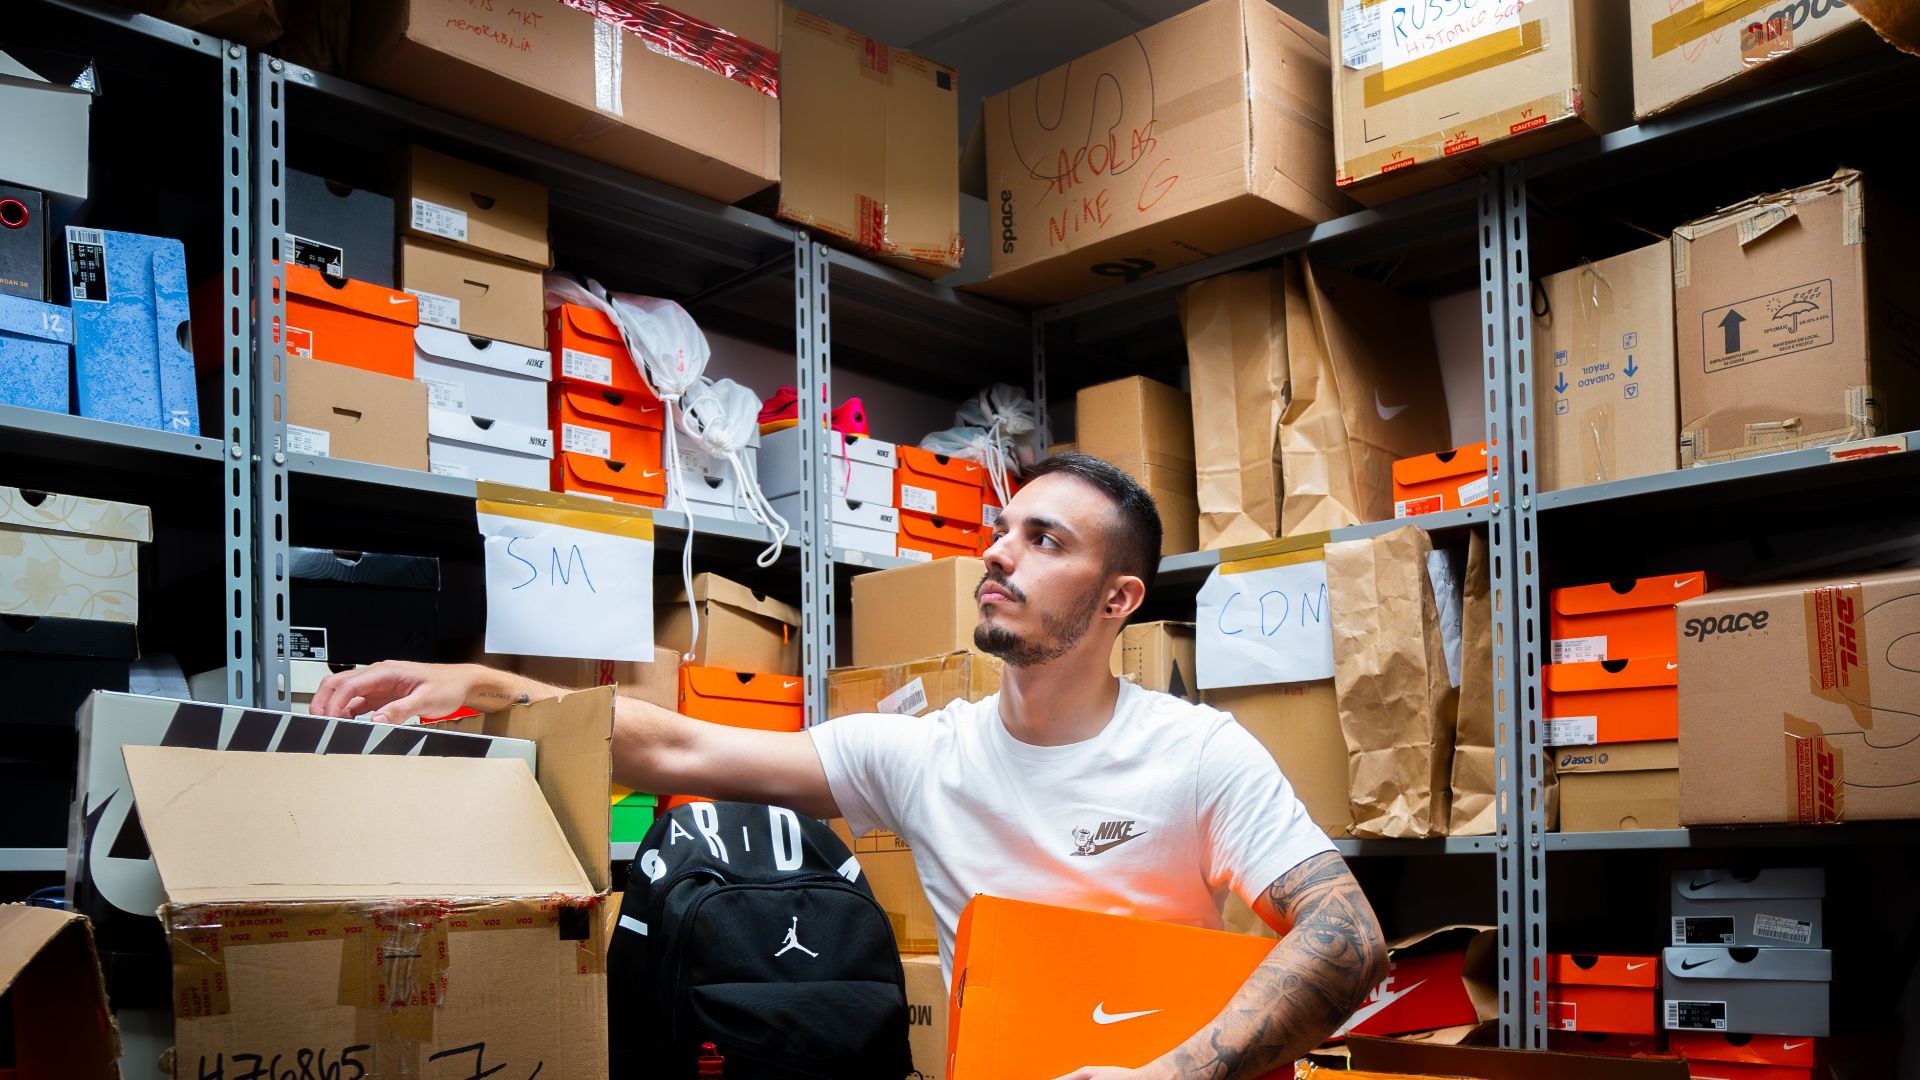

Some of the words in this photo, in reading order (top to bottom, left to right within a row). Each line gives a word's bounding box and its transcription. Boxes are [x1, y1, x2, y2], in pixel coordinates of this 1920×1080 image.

[1521, 109, 1533, 118] VT
[1512, 117, 1545, 133] CAUTION
[1454, 130, 1467, 140] VT
[1446, 139, 1477, 154] CAUTION
[1391, 150, 1403, 160] VT
[1383, 159, 1413, 173] CAUTION
[1001, 190, 1018, 254] space
[42, 312, 65, 333] 12
[526, 357, 545, 369] NIKE
[1578, 372, 1616, 388] CUIDADO
[529, 436, 548, 447] NIKE
[876, 449, 890, 458] NIKE
[880, 514, 893, 523] NIKE
[1684, 610, 1769, 642] space
[1837, 596, 1858, 672] DHL
[1571, 754, 1593, 765] asics
[1818, 752, 1835, 820] DHL
[1095, 820, 1136, 840] NIKE
[235, 907, 277, 917] ACCEPT
[239, 918, 284, 927] BROKEN
[450, 920, 468, 928] VO2
[516, 917, 533, 925] VO2
[230, 933, 250, 941] VO2
[269, 931, 289, 939] VO2
[307, 928, 327, 936] VO2
[344, 926, 363, 934] VO2
